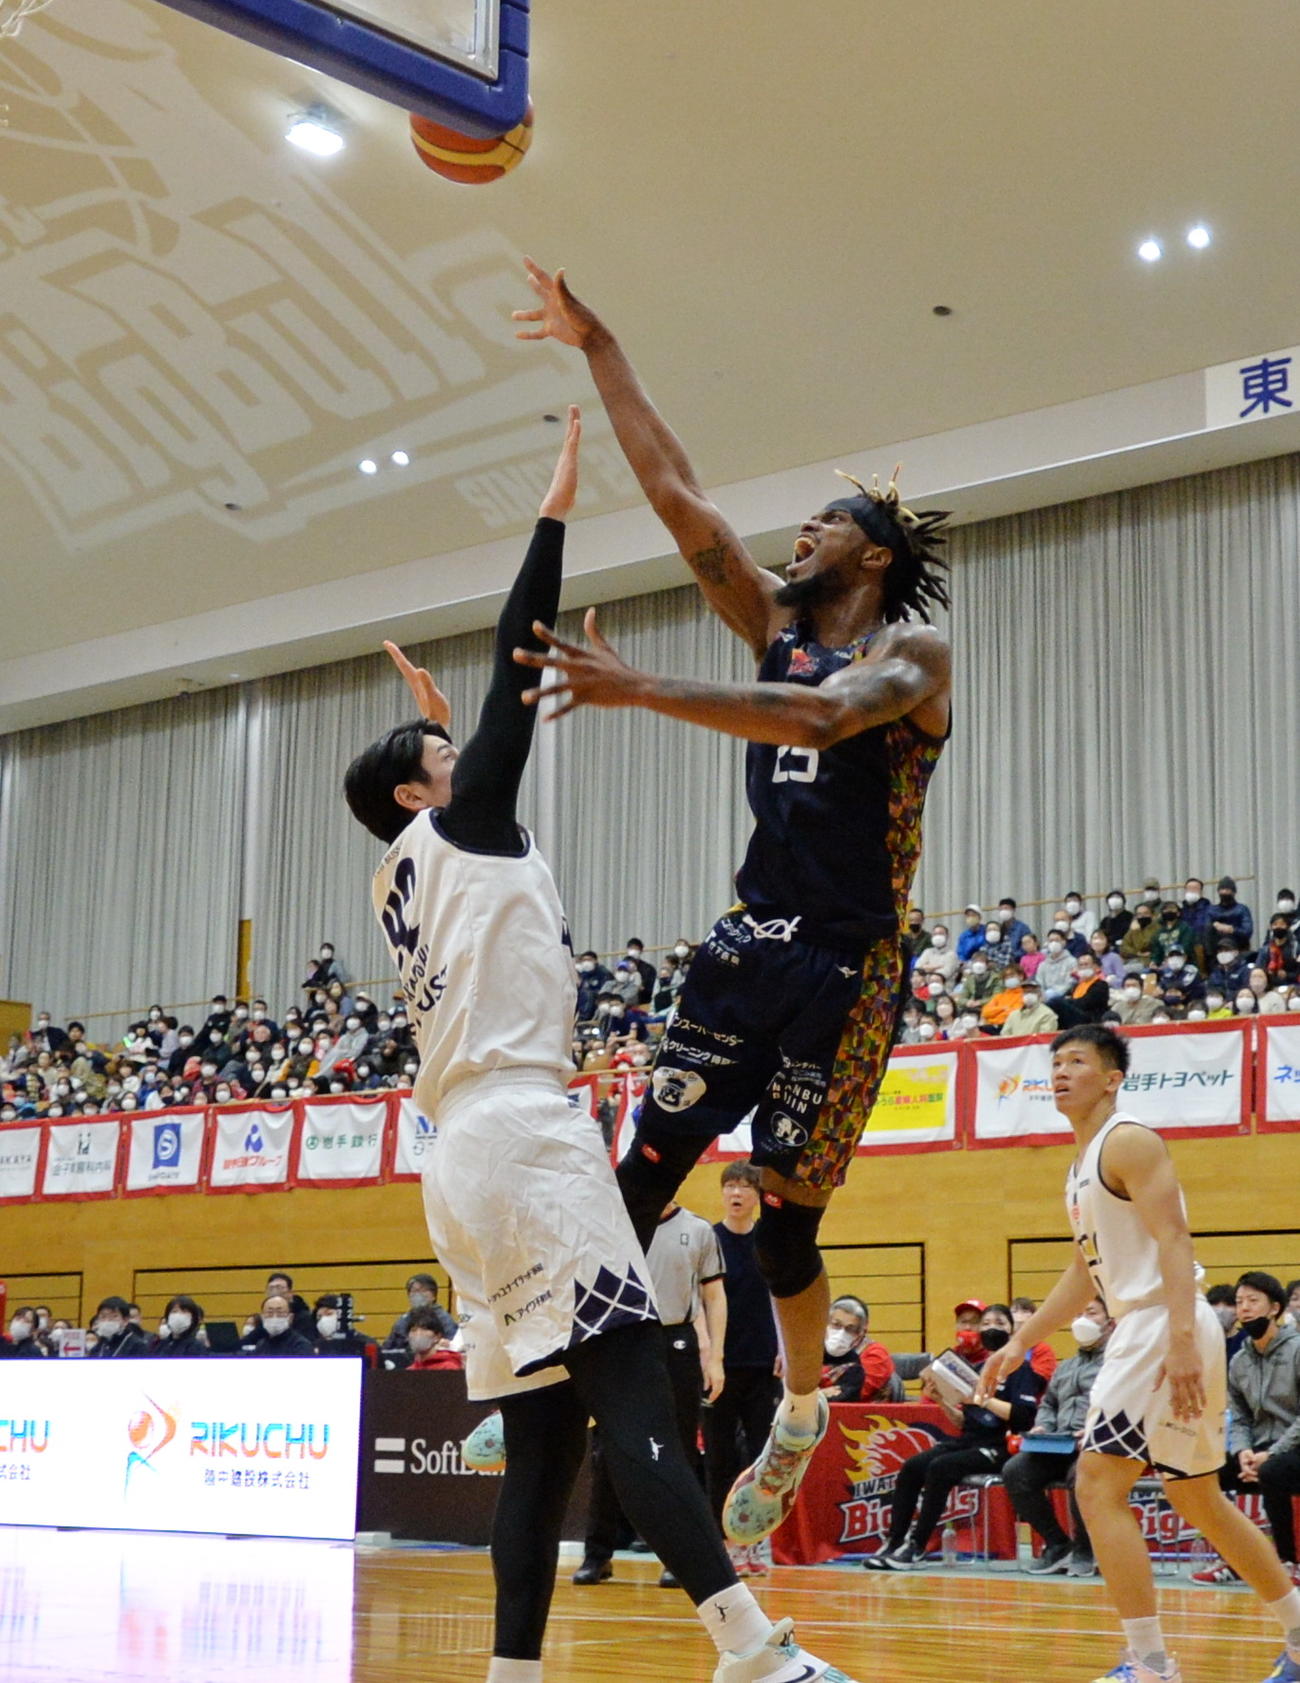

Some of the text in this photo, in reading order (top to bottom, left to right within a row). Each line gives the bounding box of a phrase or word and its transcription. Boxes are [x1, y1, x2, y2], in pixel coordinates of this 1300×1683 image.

[1239, 357, 1293, 418] 東
[1122, 1069, 1235, 1092] 岩手トヨペット
[322, 1134, 378, 1149] 岩手銀行
[190, 1421, 329, 1460] RIKUCHU
[410, 1438, 506, 1476] Soft
